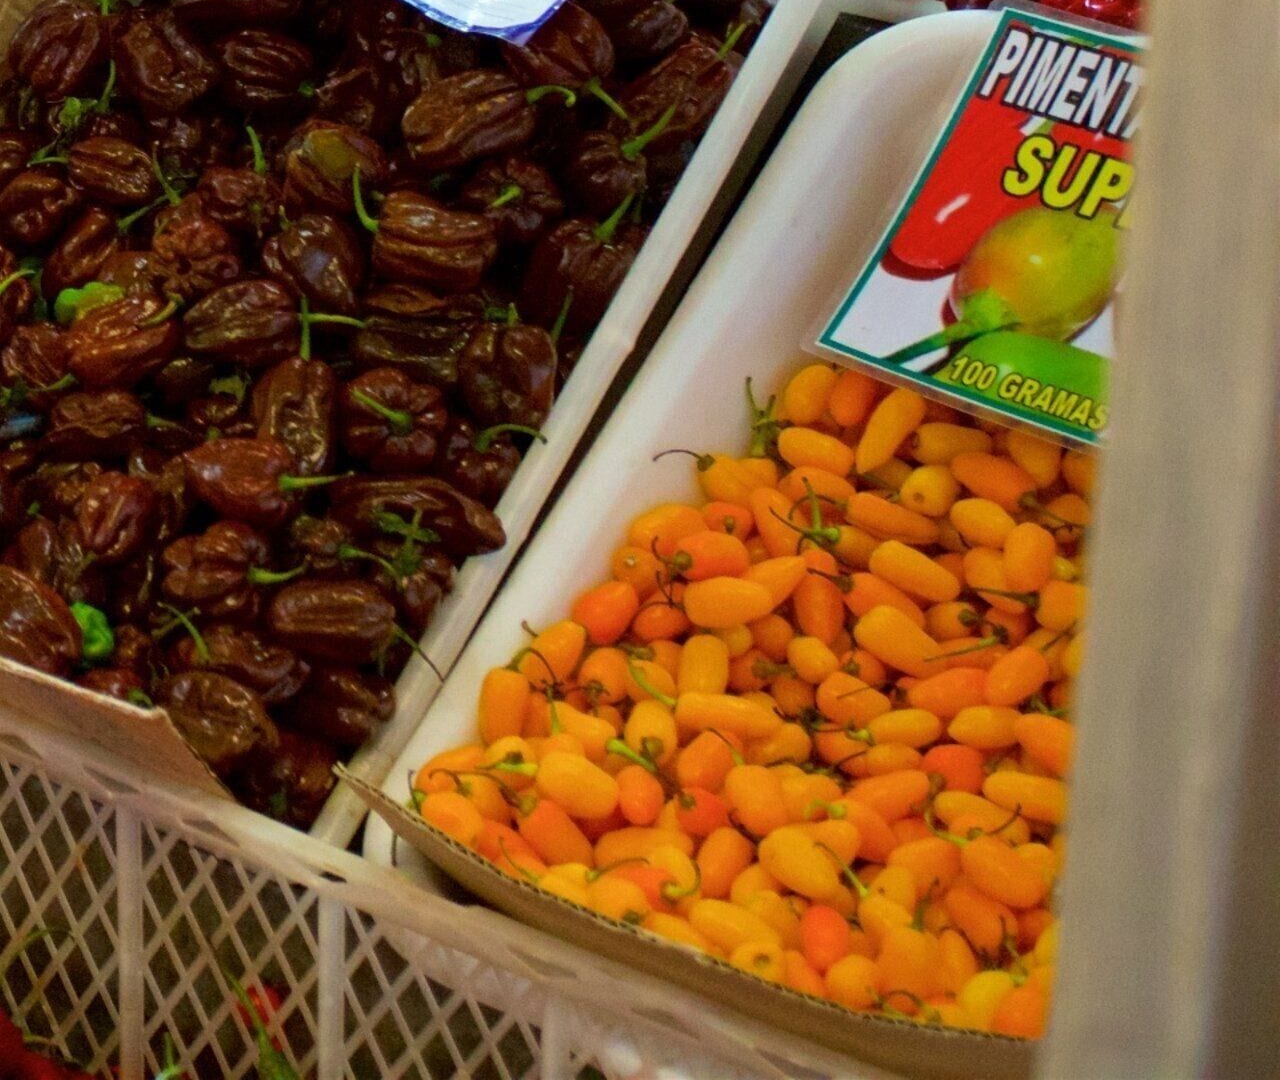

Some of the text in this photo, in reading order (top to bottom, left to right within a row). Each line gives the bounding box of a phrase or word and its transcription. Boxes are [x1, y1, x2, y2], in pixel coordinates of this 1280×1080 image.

[1002, 133, 1136, 226] SUP
[951, 355, 1108, 430] 100 GRAMAS
